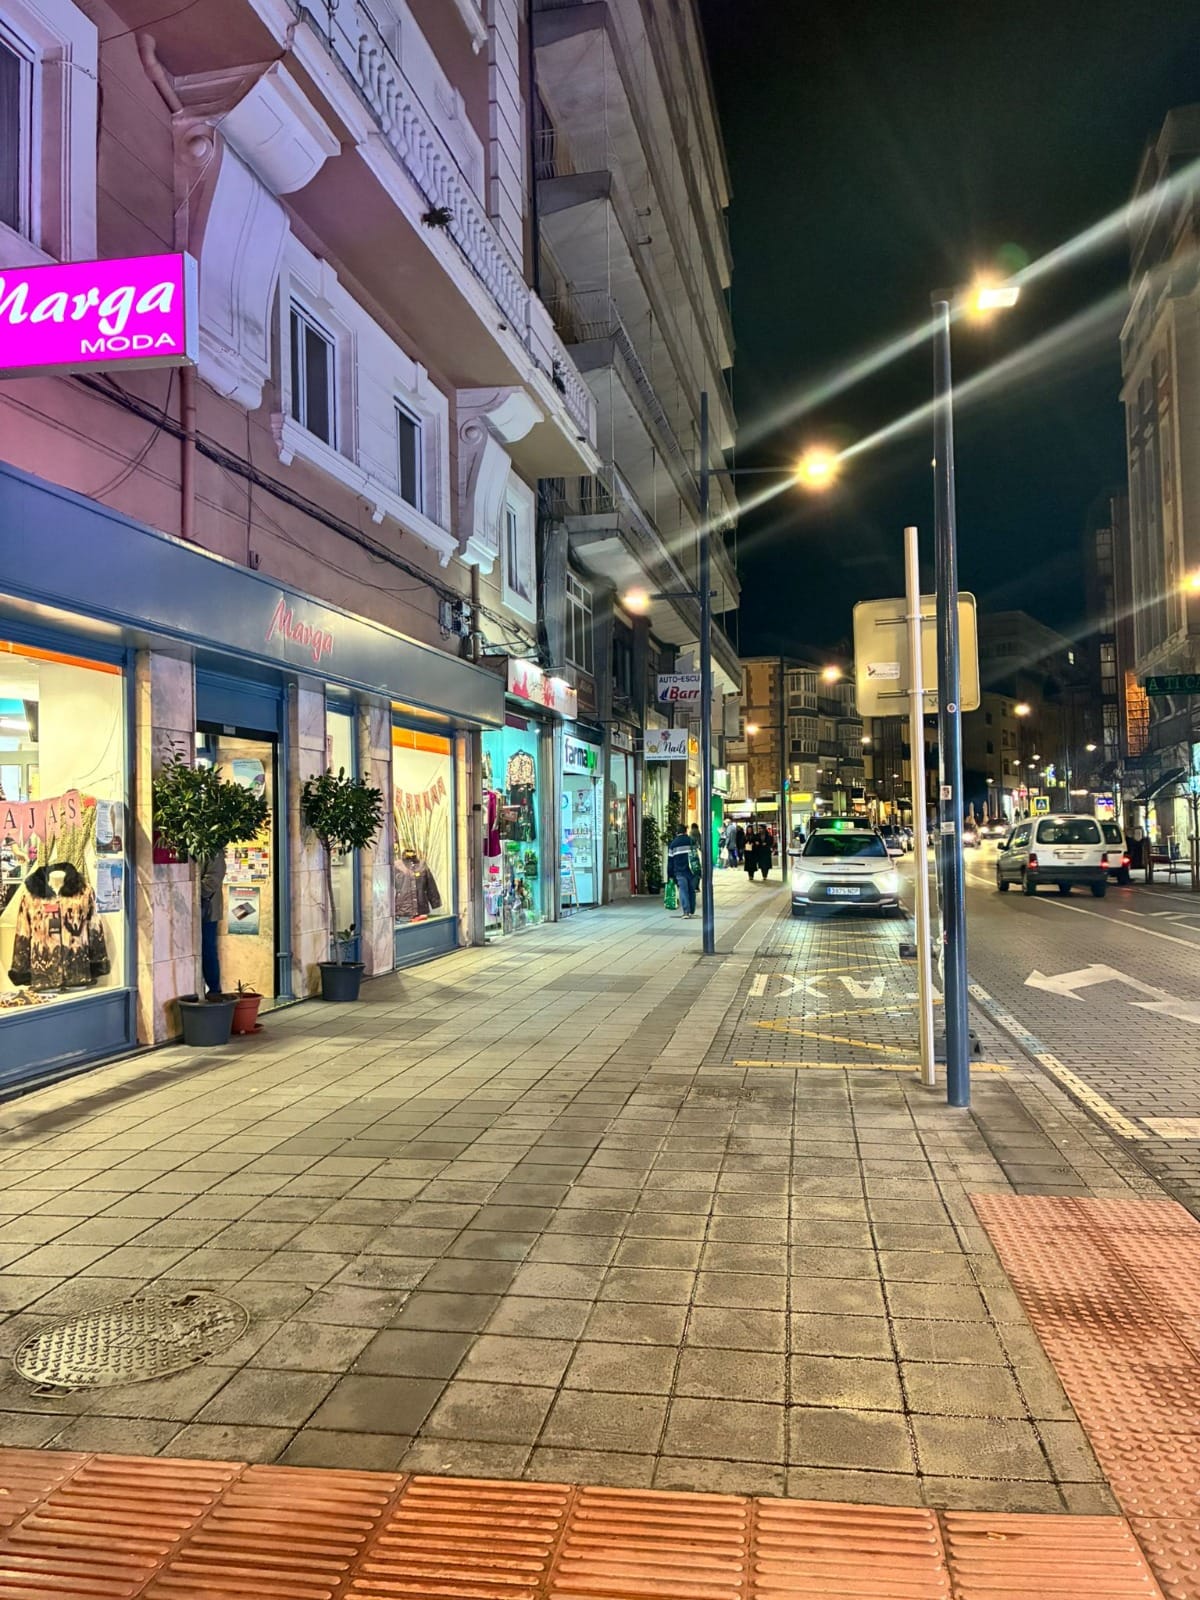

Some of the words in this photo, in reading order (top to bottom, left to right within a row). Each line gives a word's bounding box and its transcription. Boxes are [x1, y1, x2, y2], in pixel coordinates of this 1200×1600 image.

[80, 332, 176, 354] MODA
[265, 598, 334, 663] Marga
[3, 798, 76, 830] AJAS
